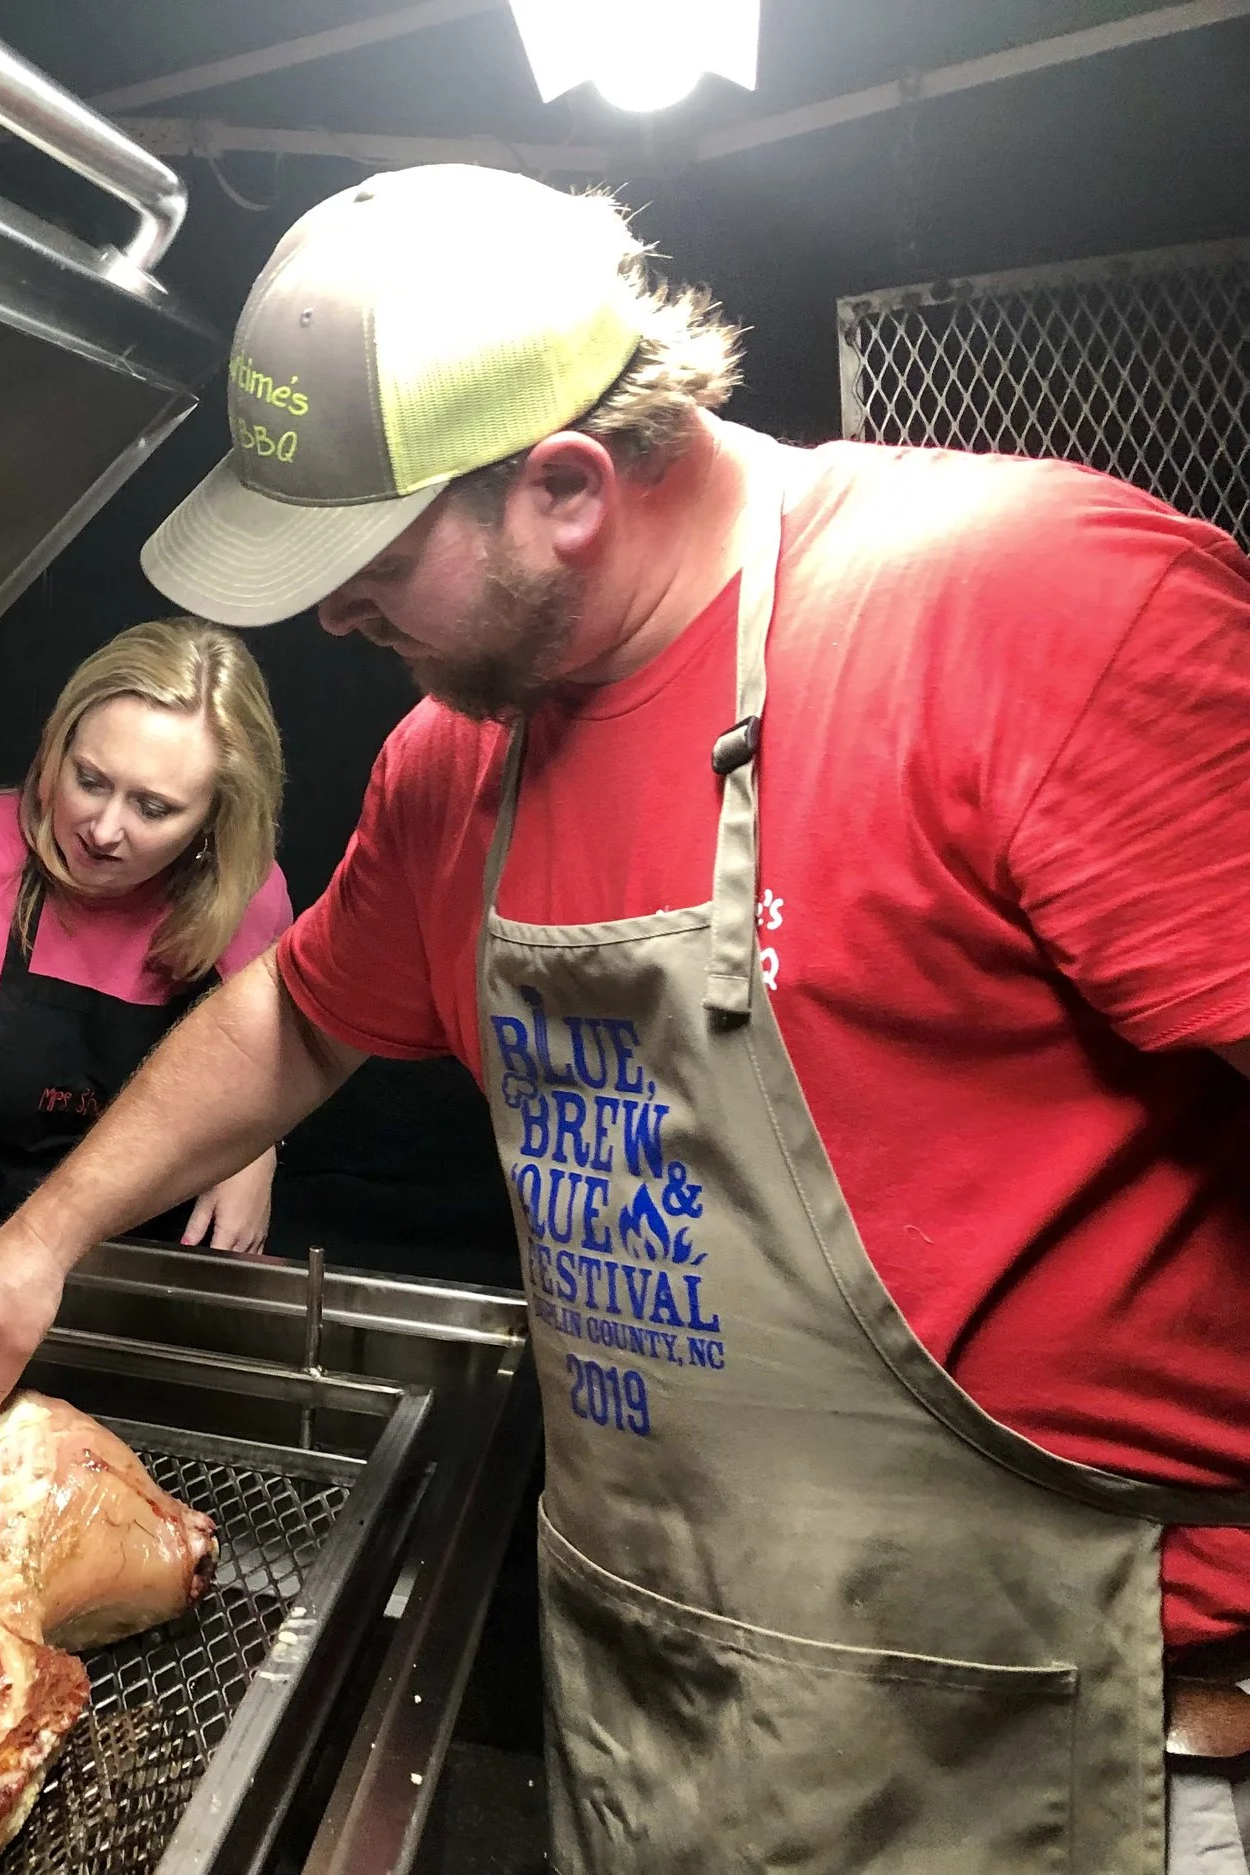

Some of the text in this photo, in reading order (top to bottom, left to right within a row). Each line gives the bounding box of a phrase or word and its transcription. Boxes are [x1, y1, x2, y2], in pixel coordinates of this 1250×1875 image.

[520, 1090, 703, 1218] BREW &
[587, 1316, 684, 1368] COUNTY,
[687, 1337, 725, 1370] NC
[565, 1353, 650, 1437] 2019
